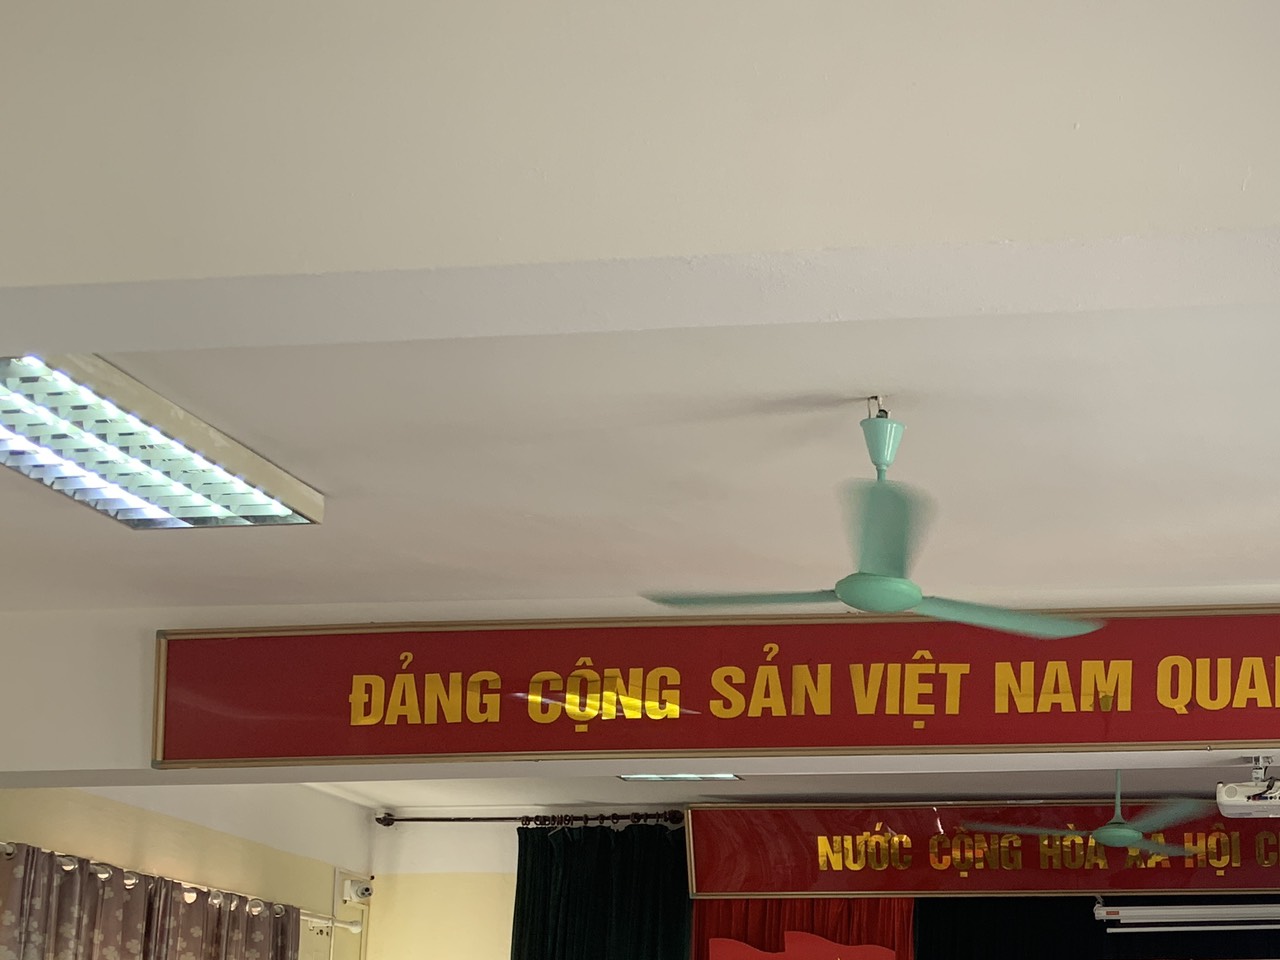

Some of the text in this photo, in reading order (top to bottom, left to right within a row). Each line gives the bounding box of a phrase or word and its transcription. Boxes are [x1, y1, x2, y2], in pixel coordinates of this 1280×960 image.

[349, 651, 501, 726] ĐẢNG
[528, 657, 680, 732] CỘNG
[709, 643, 832, 718] SẢN
[849, 650, 970, 729] VIỆT
[994, 660, 1132, 714] NAM
[817, 822, 912, 871] NƯỚC
[929, 826, 1023, 877] CỘNG
[1040, 823, 1108, 870] HÒA
[1184, 822, 1241, 876] HỘI
